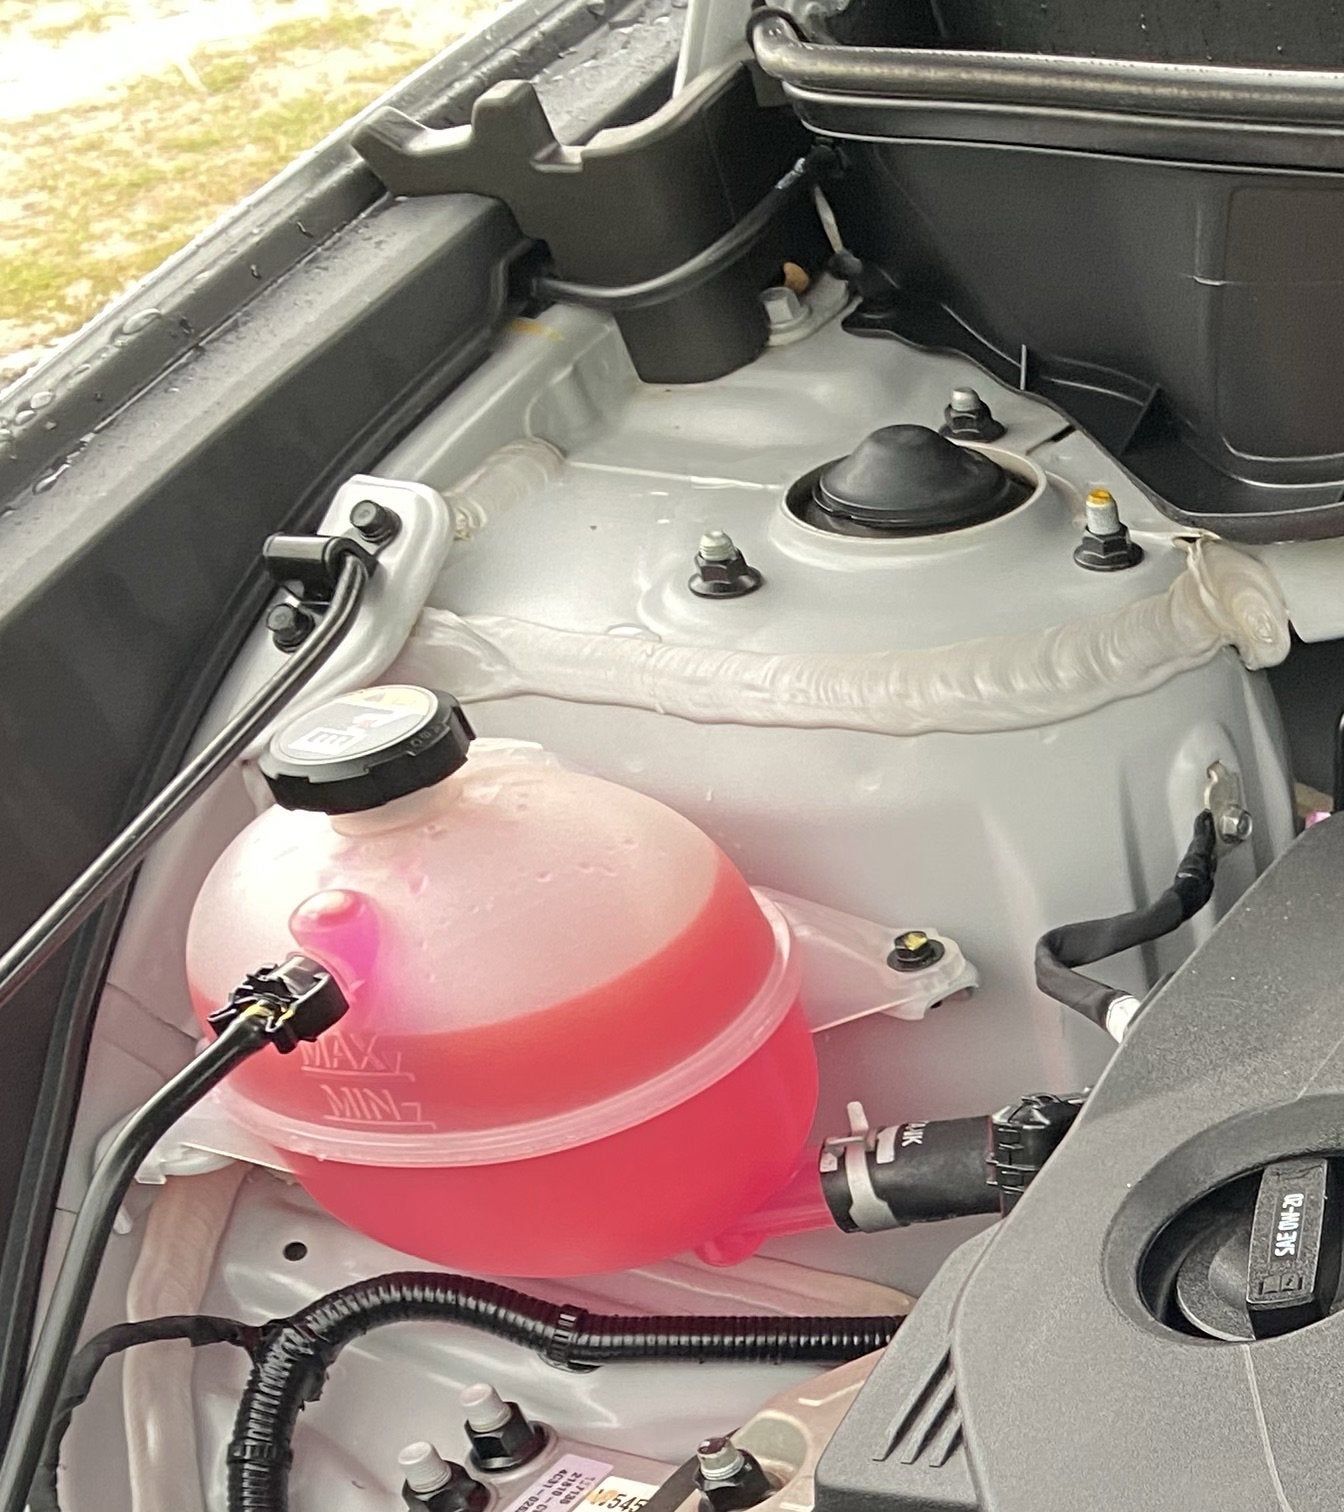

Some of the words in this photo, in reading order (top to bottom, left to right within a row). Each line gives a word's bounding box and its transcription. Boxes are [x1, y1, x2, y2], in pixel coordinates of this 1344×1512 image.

[300, 1030, 387, 1070] MAX
[319, 1083, 402, 1121] MIN
[1277, 1192, 1305, 1232] 0W-20
[1274, 1230, 1298, 1258] SAE
